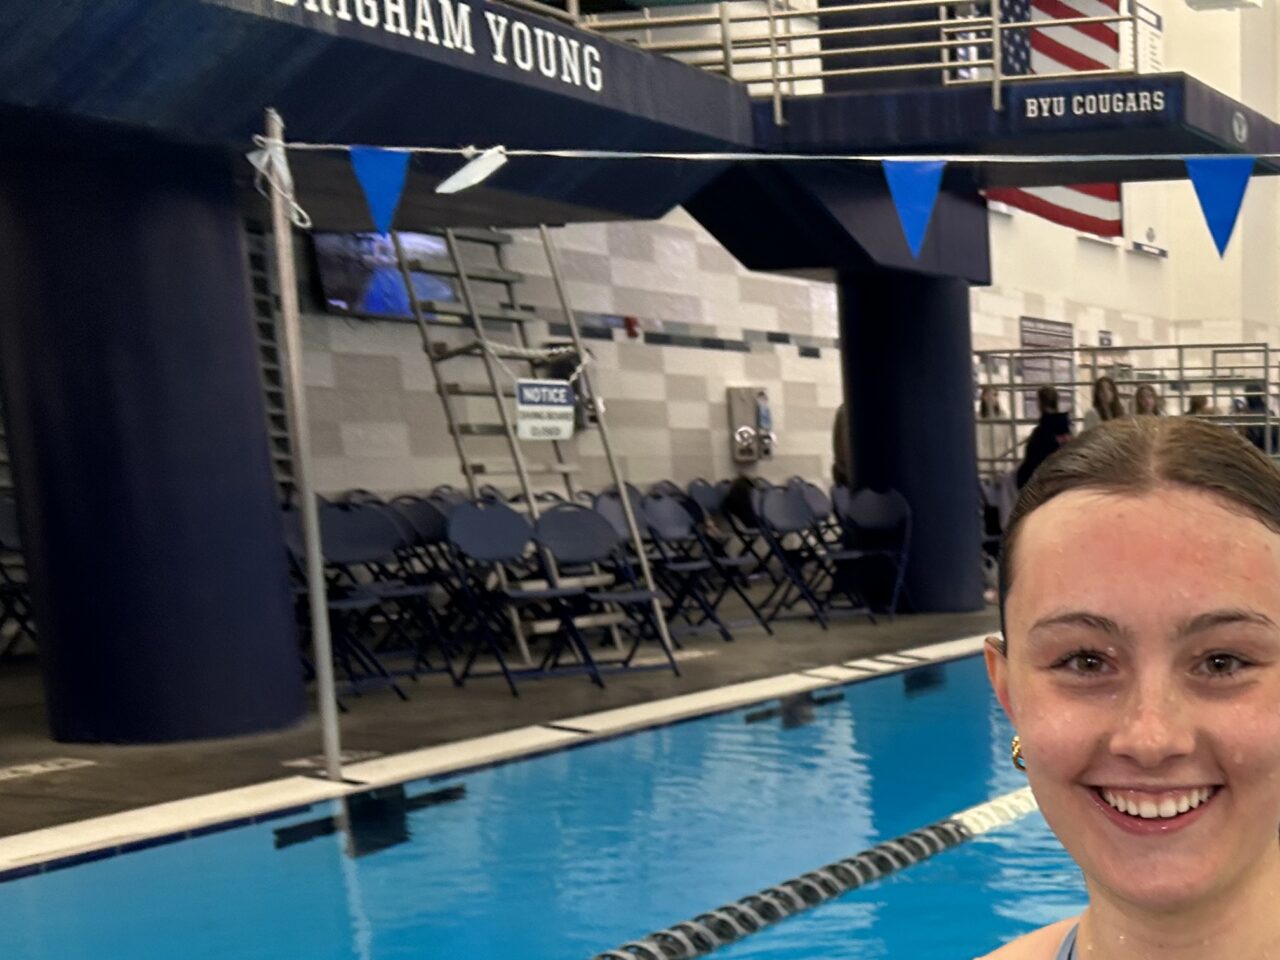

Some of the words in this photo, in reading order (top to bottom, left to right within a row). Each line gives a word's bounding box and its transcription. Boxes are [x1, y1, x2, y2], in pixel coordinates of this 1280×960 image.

[484, 10, 602, 91] YOUNG
[1025, 97, 1065, 118] BYU
[1071, 91, 1165, 115] COUGARS
[522, 387, 567, 403] NOTICE
